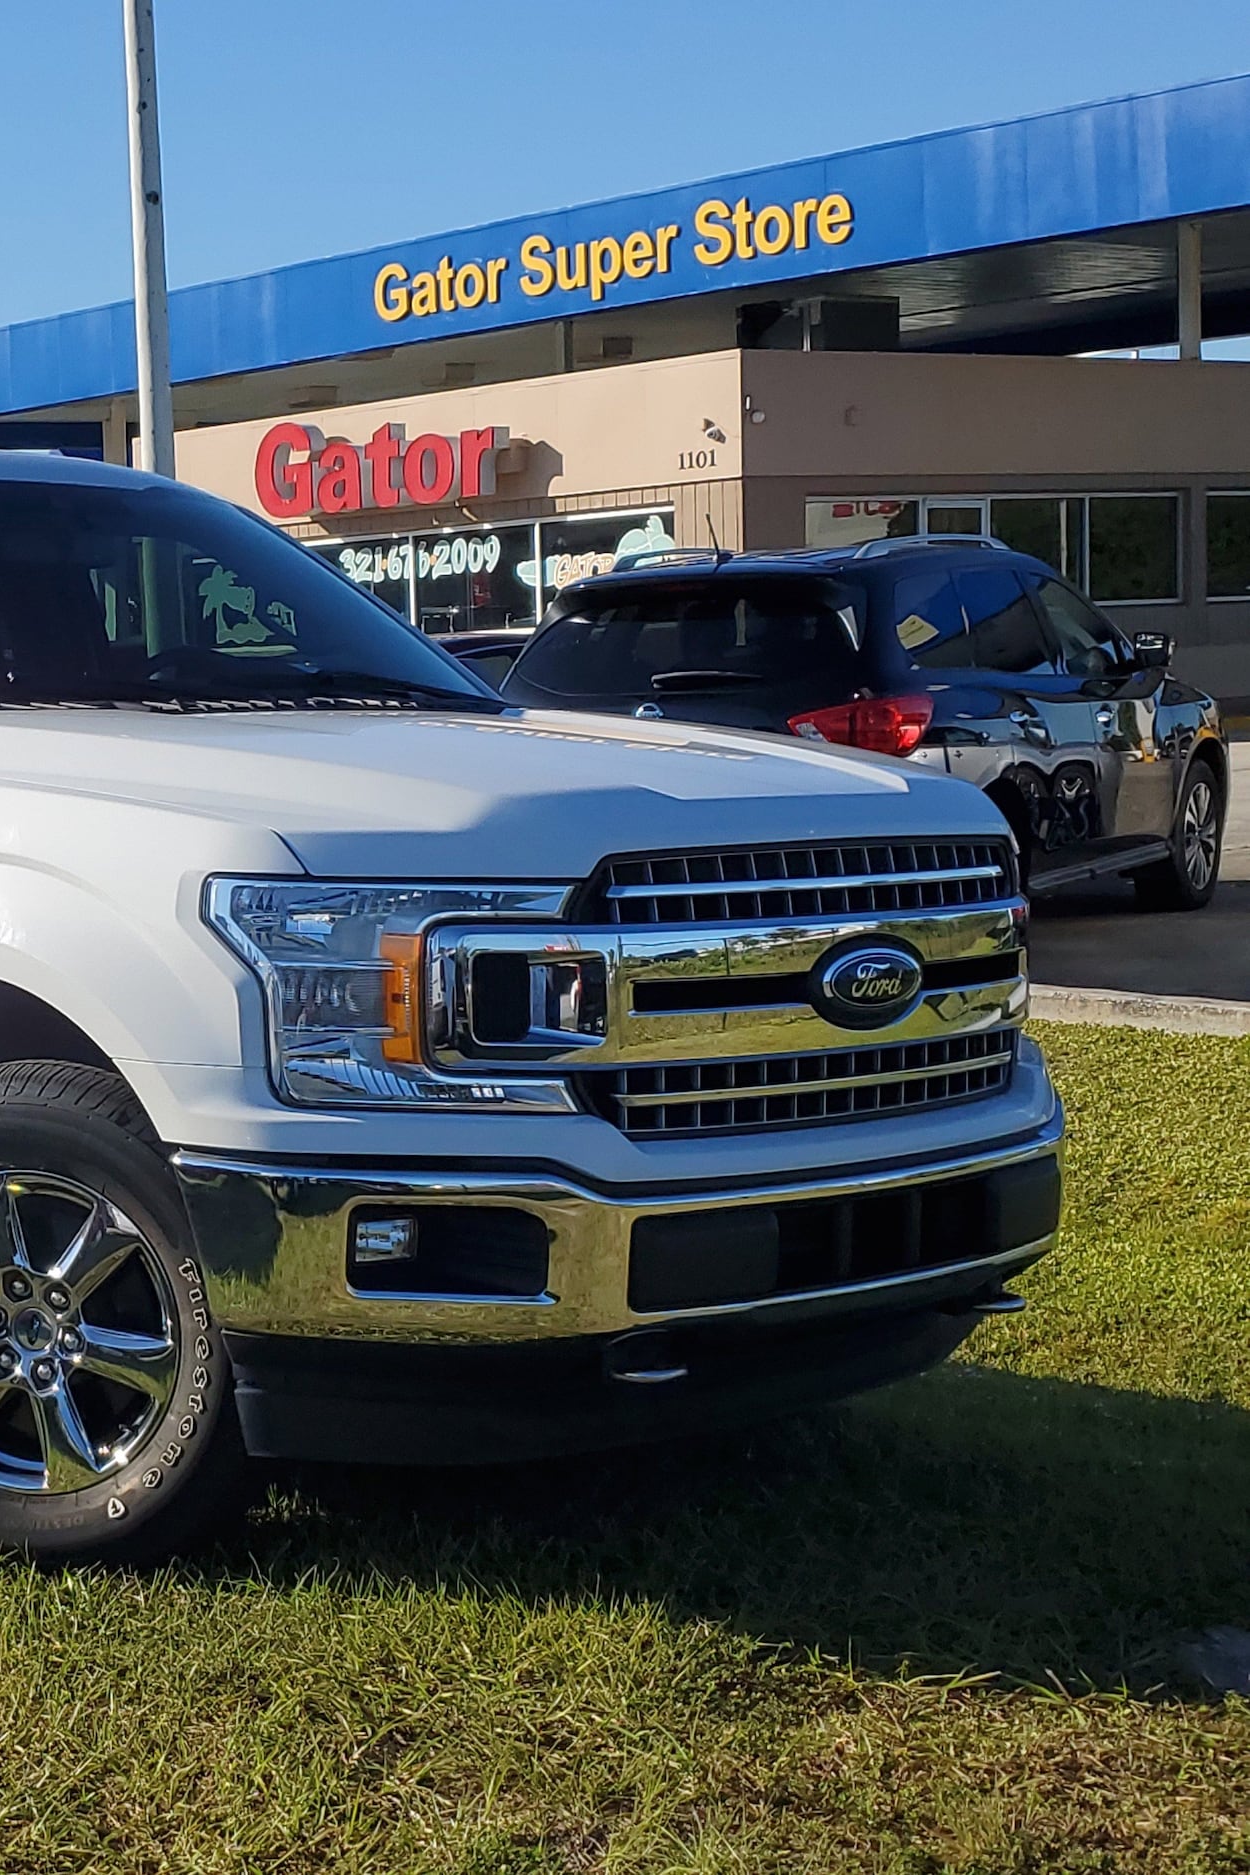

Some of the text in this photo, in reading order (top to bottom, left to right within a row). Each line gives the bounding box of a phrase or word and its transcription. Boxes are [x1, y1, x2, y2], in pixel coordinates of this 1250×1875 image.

[373, 193, 853, 322] Gator Super Store
[254, 422, 502, 518] Gator
[677, 448, 718, 472] 1101
[851, 962, 902, 998] Ford
[142, 1257, 210, 1488] Firestone
